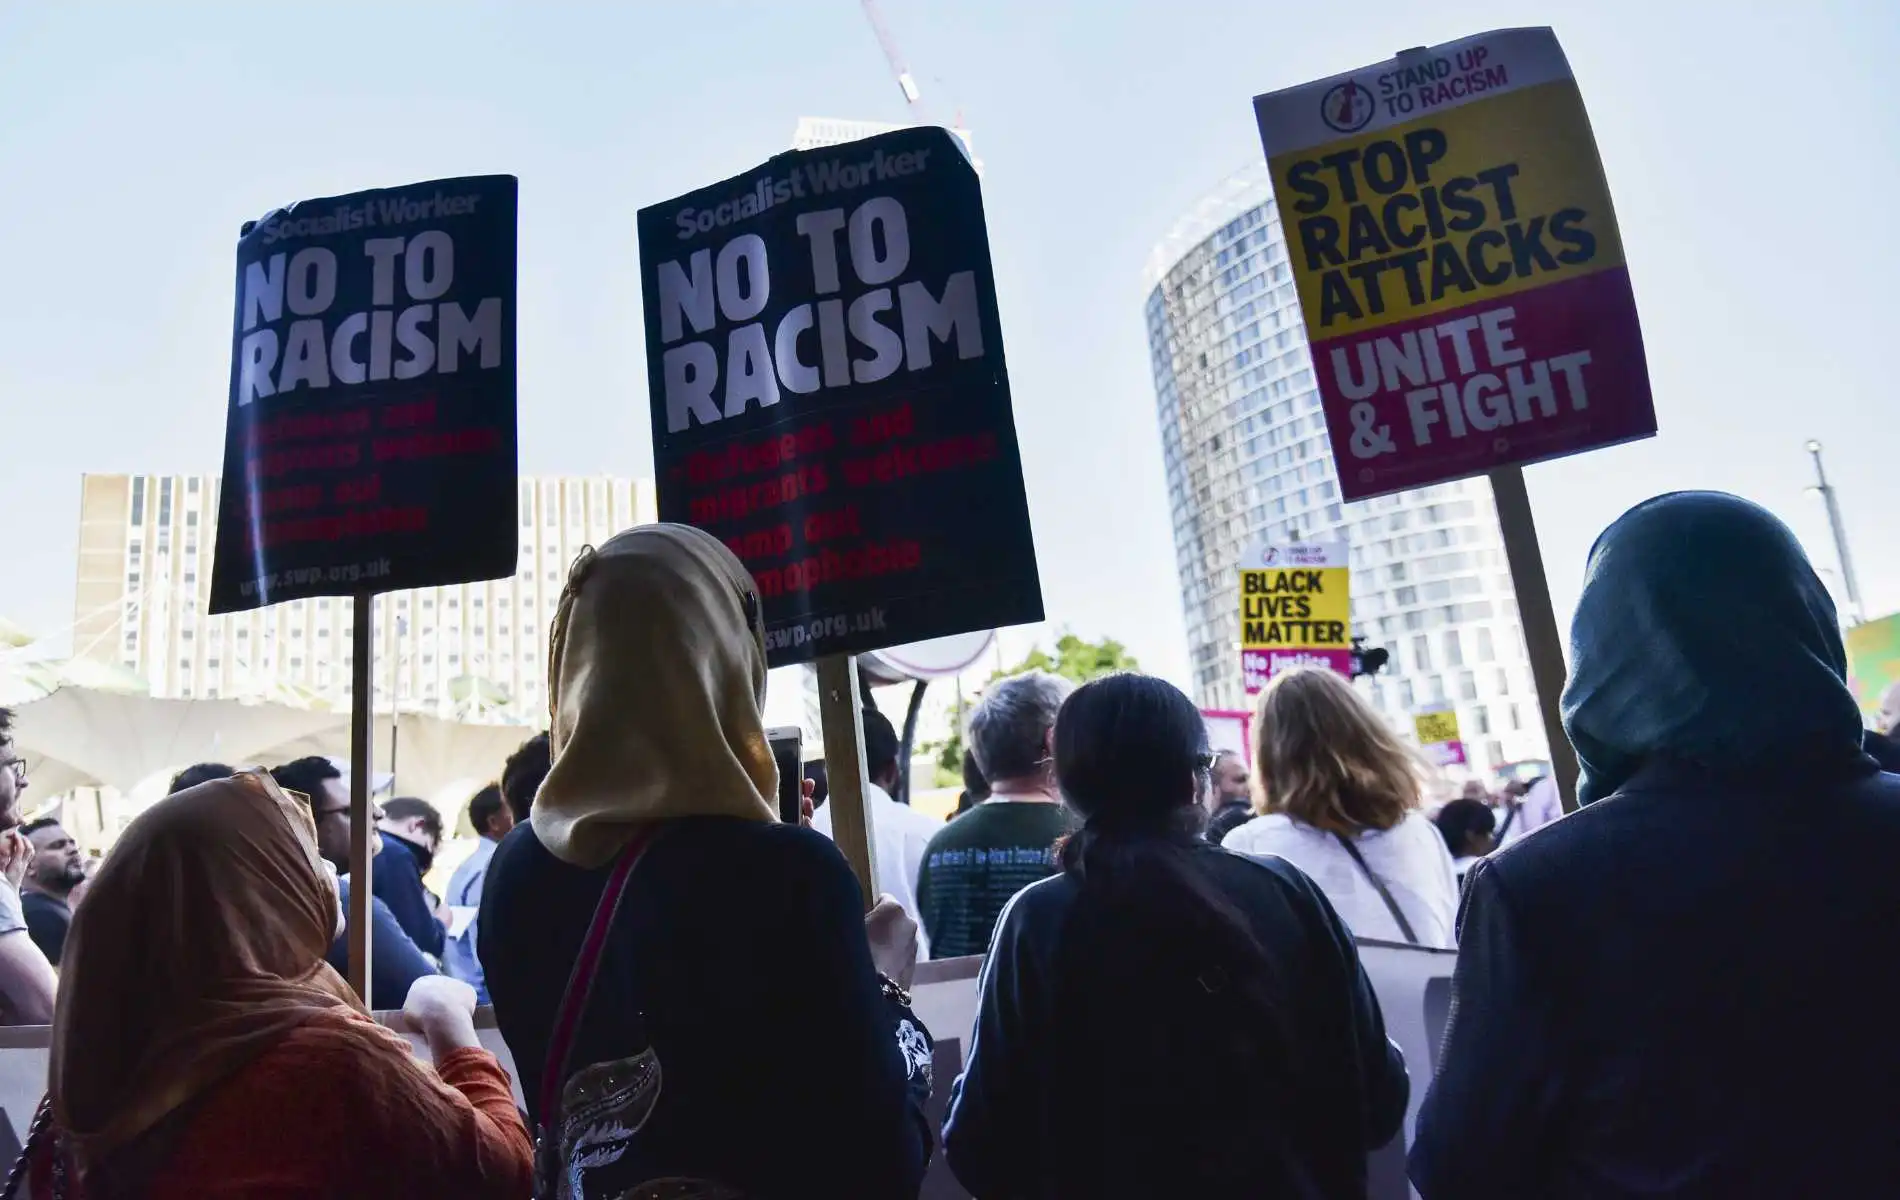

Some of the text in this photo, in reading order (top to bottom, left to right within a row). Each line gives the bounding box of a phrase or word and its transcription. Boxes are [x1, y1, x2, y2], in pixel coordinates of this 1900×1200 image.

[1377, 45, 1489, 97] STAND UP
[1386, 65, 1508, 118] TO RACISM
[1286, 127, 1448, 213] STOP
[1299, 163, 1520, 271] RACIST
[243, 230, 454, 331] NO TO
[657, 197, 910, 343] NO TO
[1320, 207, 1597, 327] ATTACKS
[238, 297, 502, 407] RACISM
[663, 270, 984, 433] RACISM
[1331, 306, 1526, 400] UNITE
[850, 401, 914, 446] and
[1349, 350, 1592, 460] & FIGHT
[755, 535, 921, 597] mophobia
[1244, 570, 1324, 594] BLACK
[1244, 596, 1311, 618] LIVES
[765, 603, 886, 650] swp.org.uk
[1244, 621, 1345, 644] MATTER
